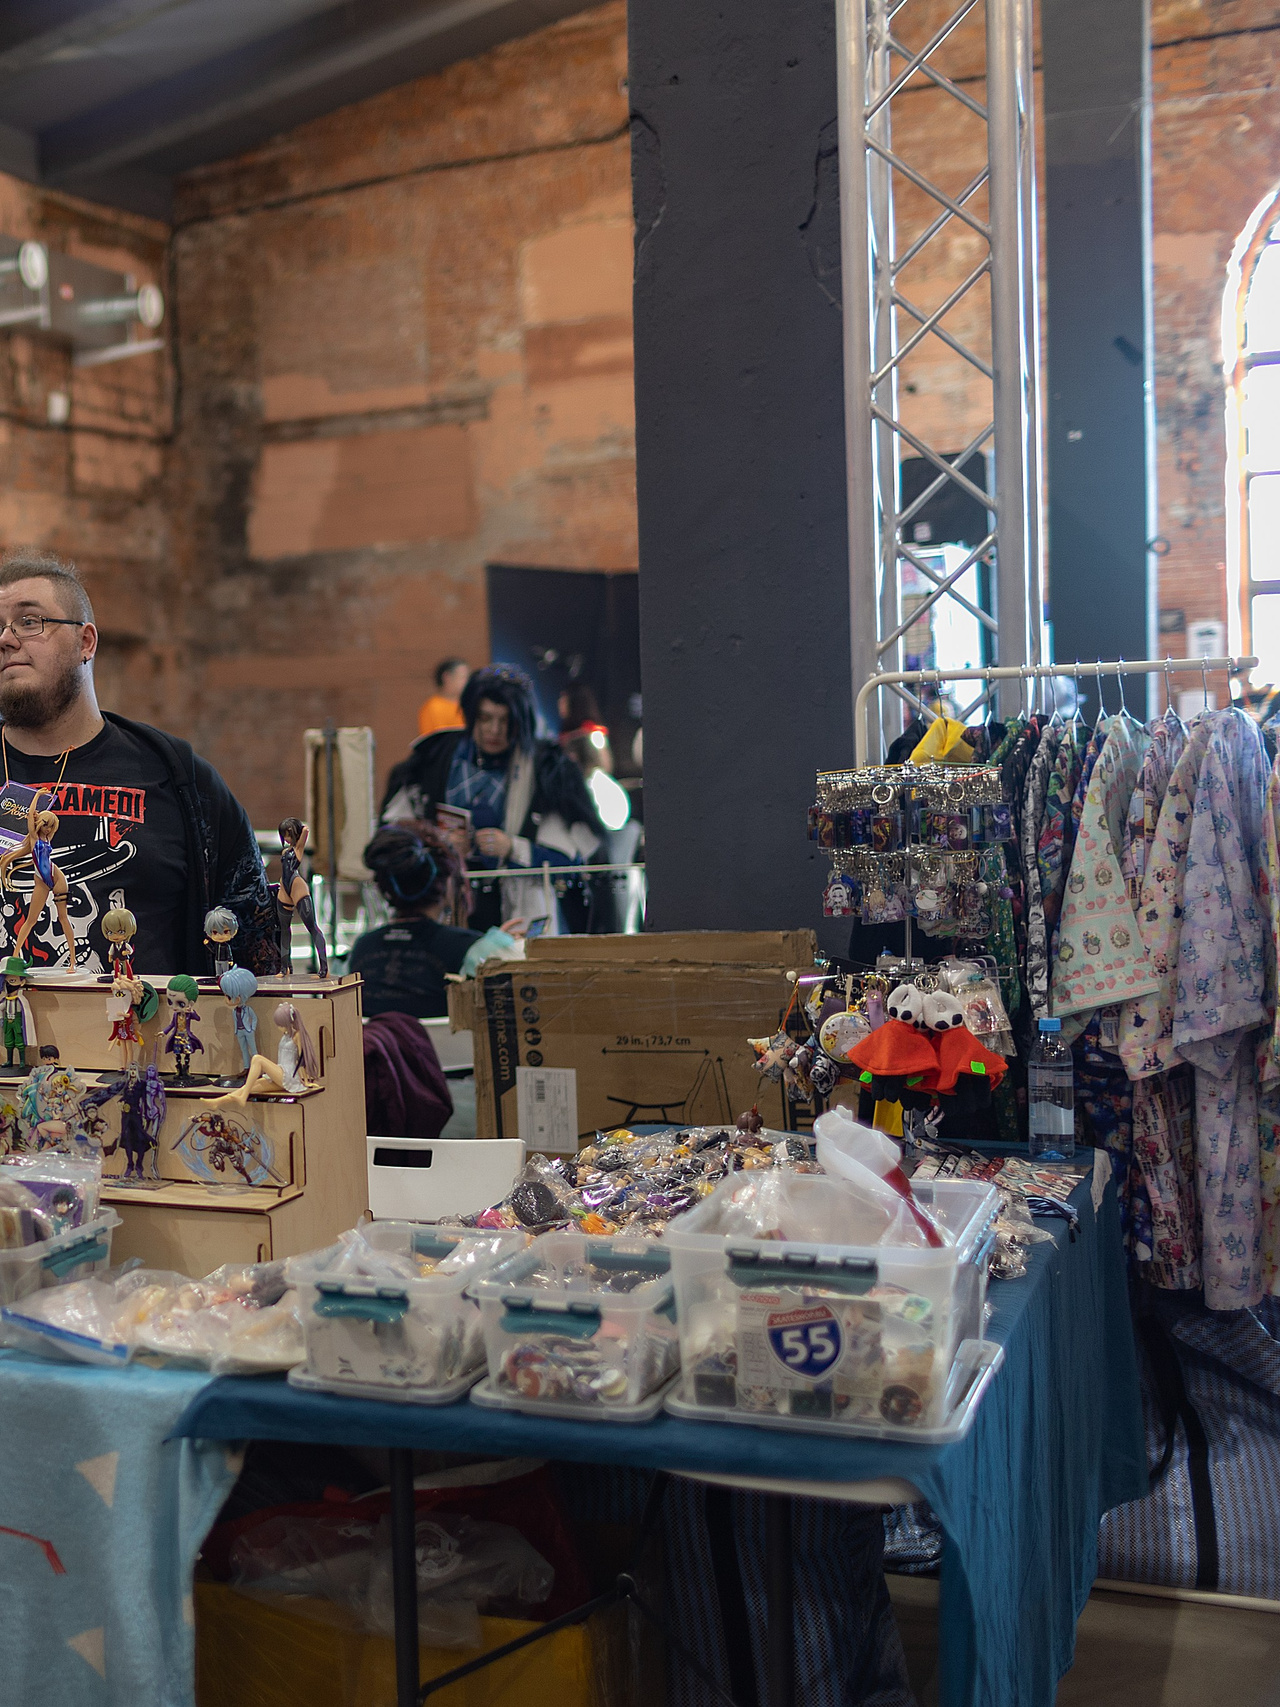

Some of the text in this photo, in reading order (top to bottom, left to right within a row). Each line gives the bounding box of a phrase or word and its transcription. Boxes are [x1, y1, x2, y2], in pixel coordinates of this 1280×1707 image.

[51, 786, 141, 819] SAMEDI
[616, 1035, 629, 1046] 29
[675, 1037, 691, 1046] cm
[781, 1325, 835, 1364] 55
